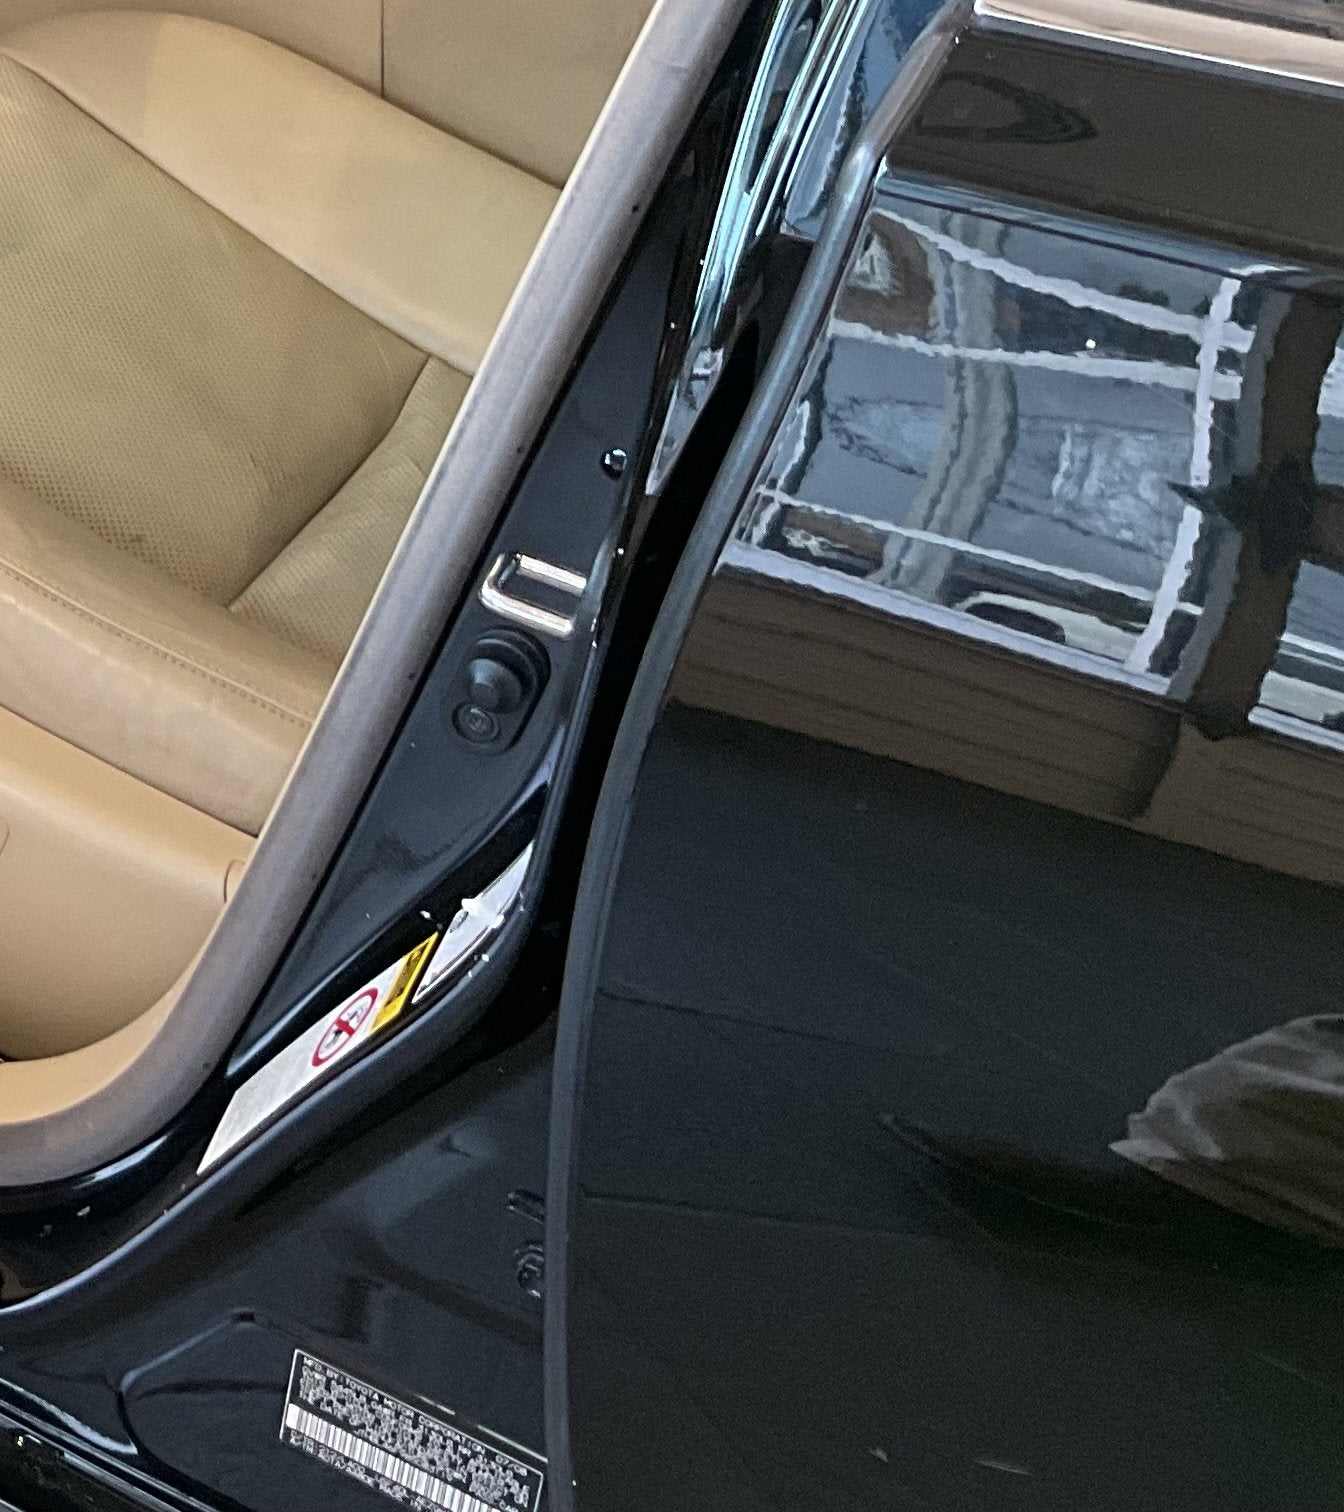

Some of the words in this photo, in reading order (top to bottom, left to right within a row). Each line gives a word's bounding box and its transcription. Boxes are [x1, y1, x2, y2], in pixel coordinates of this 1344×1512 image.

[345, 1376, 379, 1401] TOYOTA
[383, 1396, 415, 1419] MOTOR
[418, 1414, 486, 1455] CORPORATION
